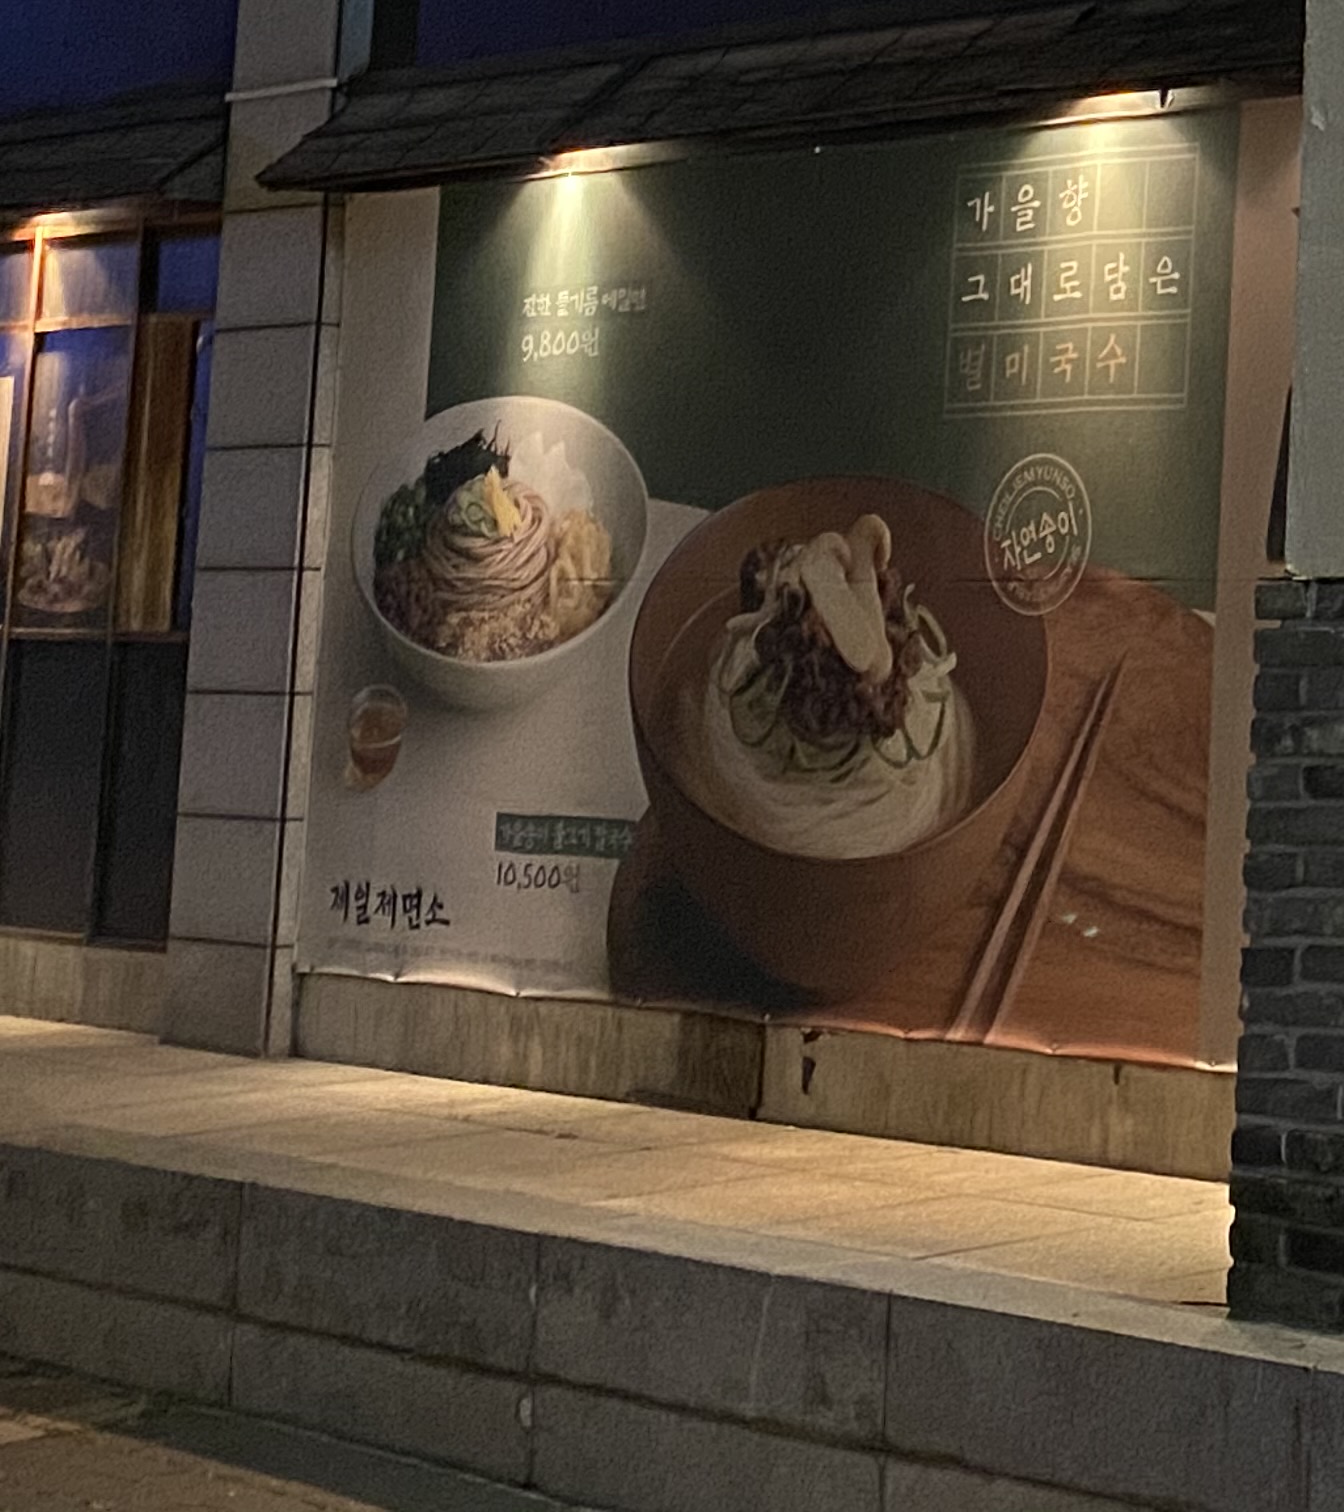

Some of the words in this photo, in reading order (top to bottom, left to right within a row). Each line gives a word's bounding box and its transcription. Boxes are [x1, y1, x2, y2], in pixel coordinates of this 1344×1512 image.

[967, 174, 1088, 232] 가을향
[556, 285, 599, 318] 들기름
[521, 327, 600, 363] 9,800원
[959, 333, 1126, 392] 별미국수
[1000, 500, 1078, 571] 자연송이
[496, 861, 580, 893] 10,500원
[330, 879, 450, 930] 제일제면소
